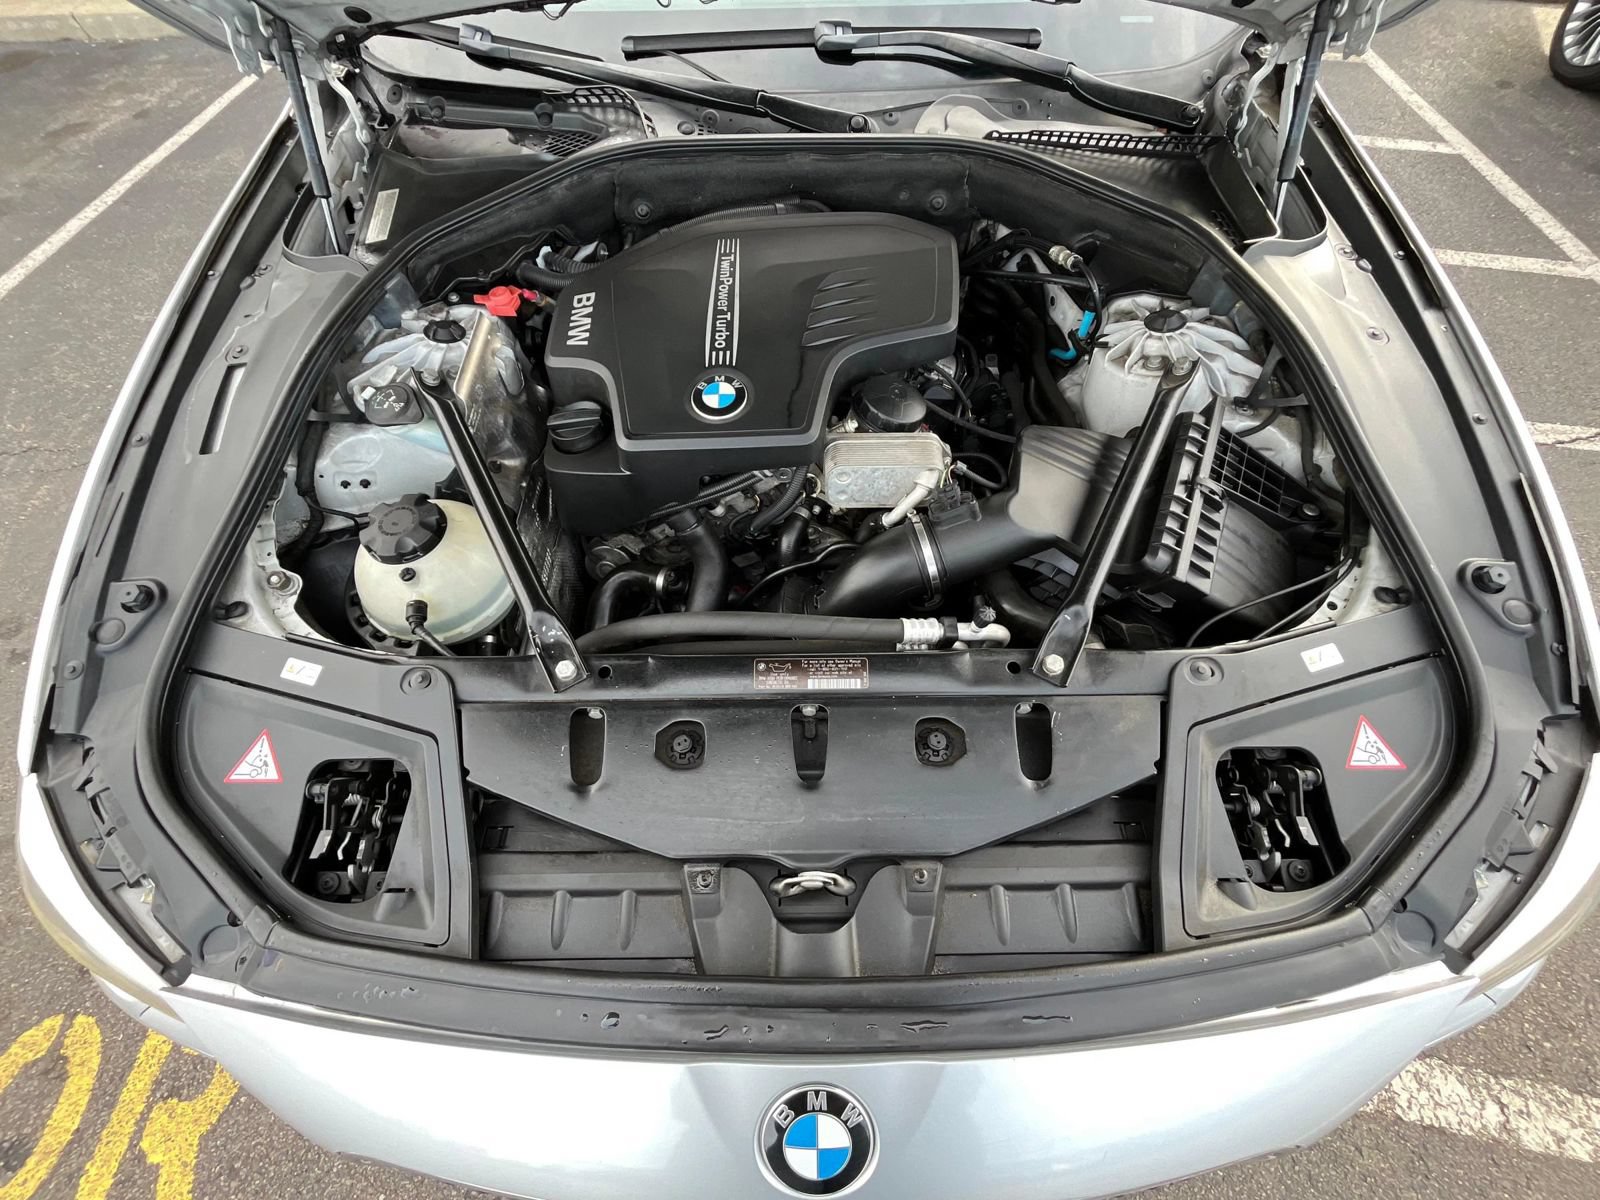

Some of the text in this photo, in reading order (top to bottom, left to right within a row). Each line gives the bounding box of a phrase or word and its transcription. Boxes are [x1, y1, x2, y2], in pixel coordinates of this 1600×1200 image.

[566, 291, 596, 345] BMW
[714, 253, 735, 348] TwinPower Turbo
[697, 375, 743, 390] BMW
[772, 1090, 864, 1129] BMW
